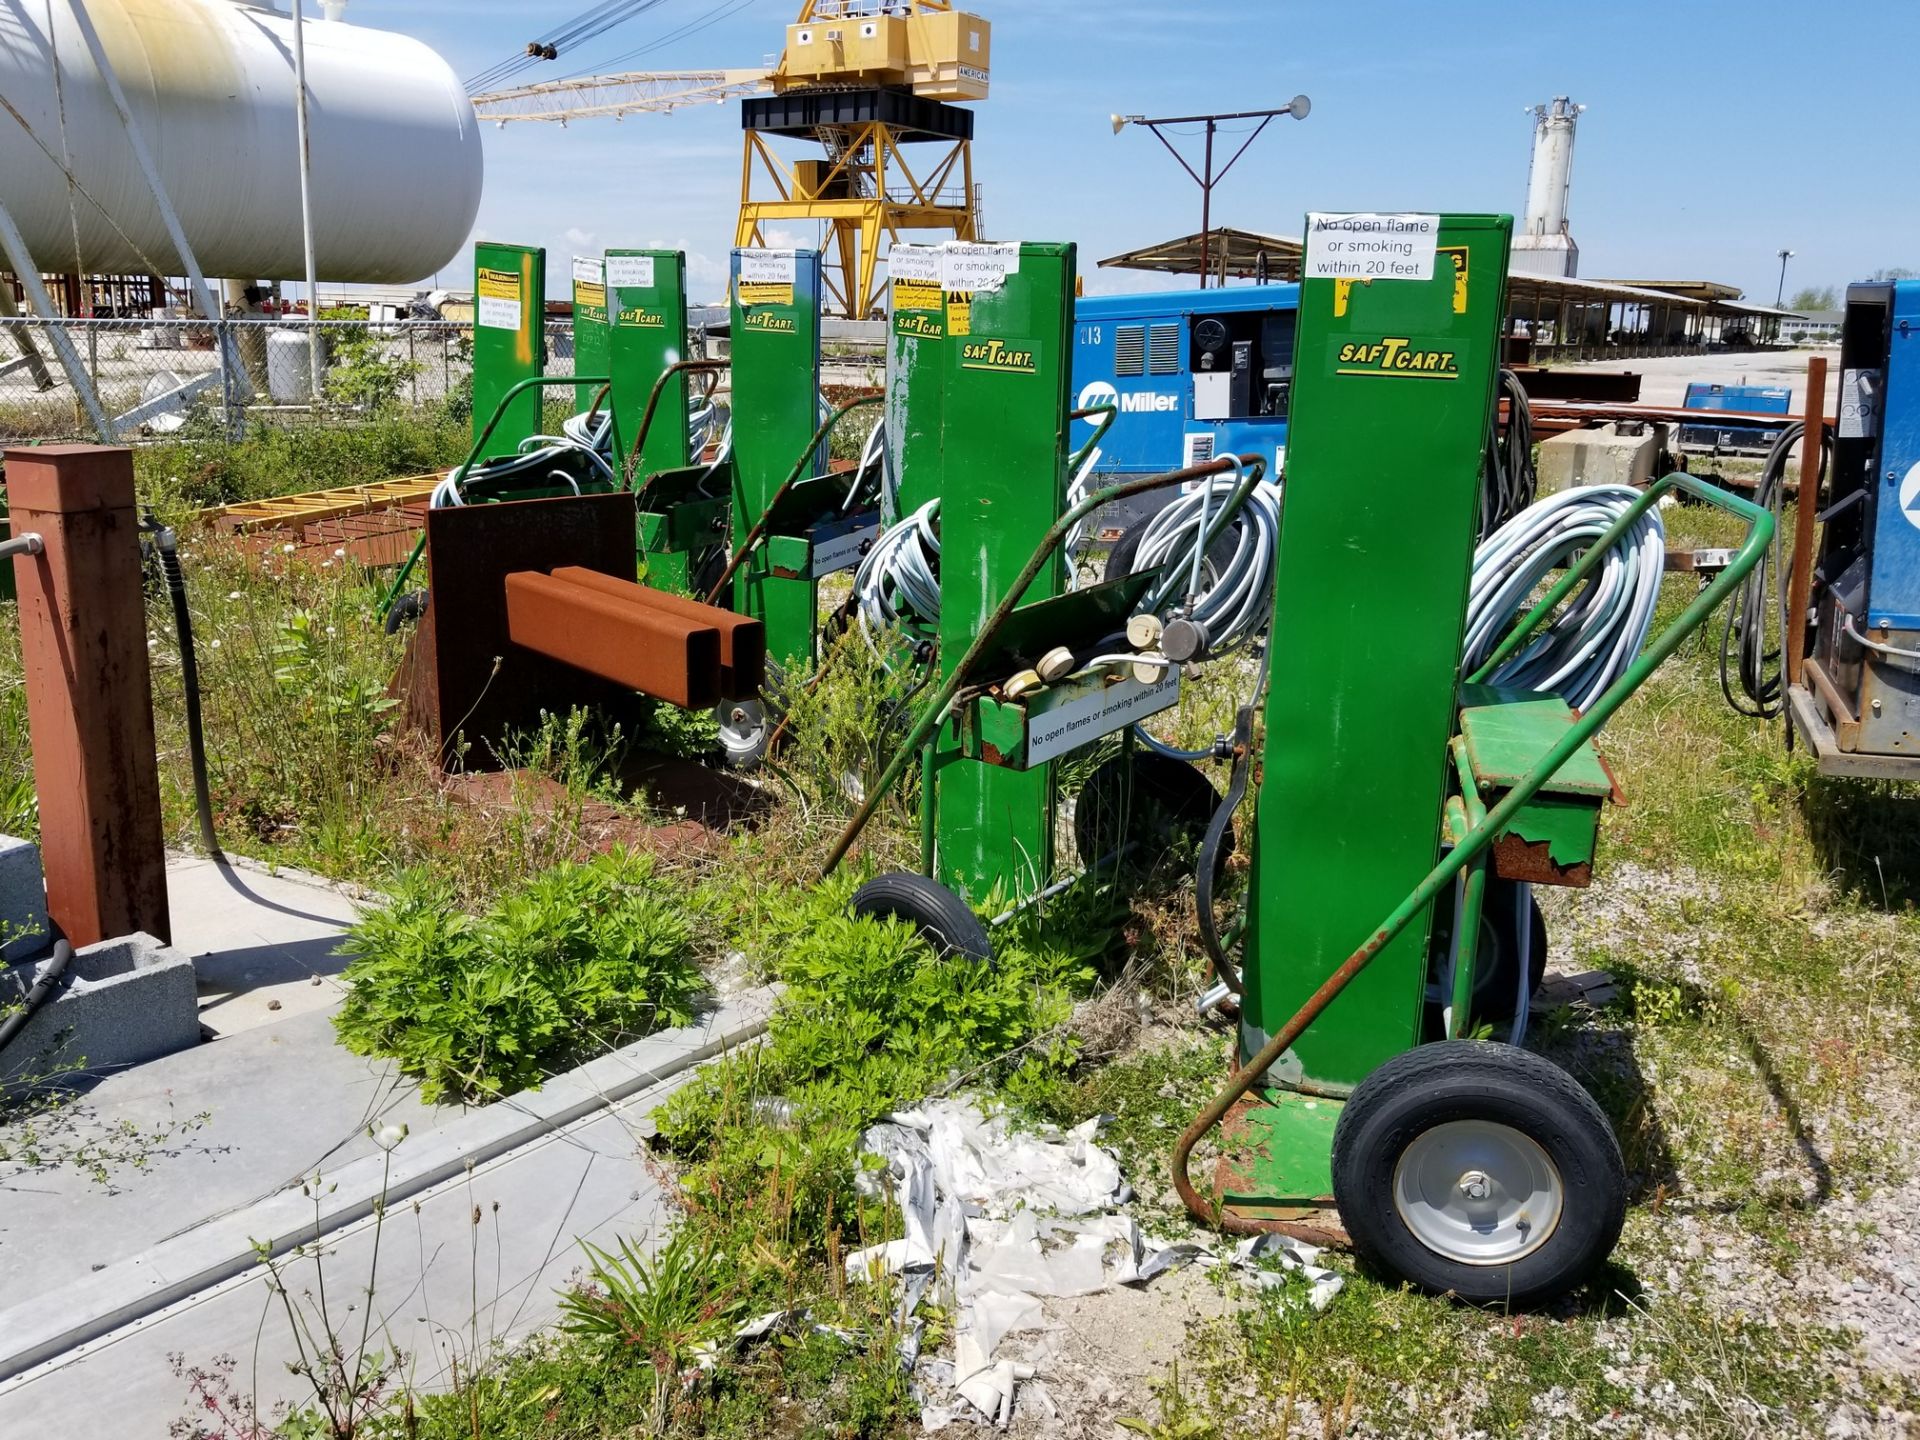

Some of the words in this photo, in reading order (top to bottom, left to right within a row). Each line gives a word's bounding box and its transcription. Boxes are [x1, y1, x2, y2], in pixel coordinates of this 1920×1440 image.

[960, 67, 989, 80] AMERICAN
[1317, 218, 1338, 231] No
[1343, 219, 1381, 234] open
[1387, 218, 1429, 232] flame
[946, 245, 959, 255] No
[962, 246, 984, 256] open
[987, 245, 1014, 255] flame
[1328, 241, 1344, 251] or
[1348, 240, 1413, 256] smoking
[905, 257, 935, 268] smoking
[966, 262, 1005, 272] smoking
[1317, 260, 1360, 273] within
[1366, 261, 1385, 274] 20
[1390, 261, 1420, 275] feet
[949, 278, 975, 287] within
[898, 315, 942, 335] SAFTCAR
[1032, 735, 1043, 747] No
[1045, 727, 1065, 743] open
[1066, 715, 1091, 733] flames
[1092, 711, 1101, 720] or
[1102, 697, 1133, 717] smoking
[1133, 687, 1154, 703] within
[1155, 683, 1164, 694] 20
[1164, 677, 1177, 690] feet
